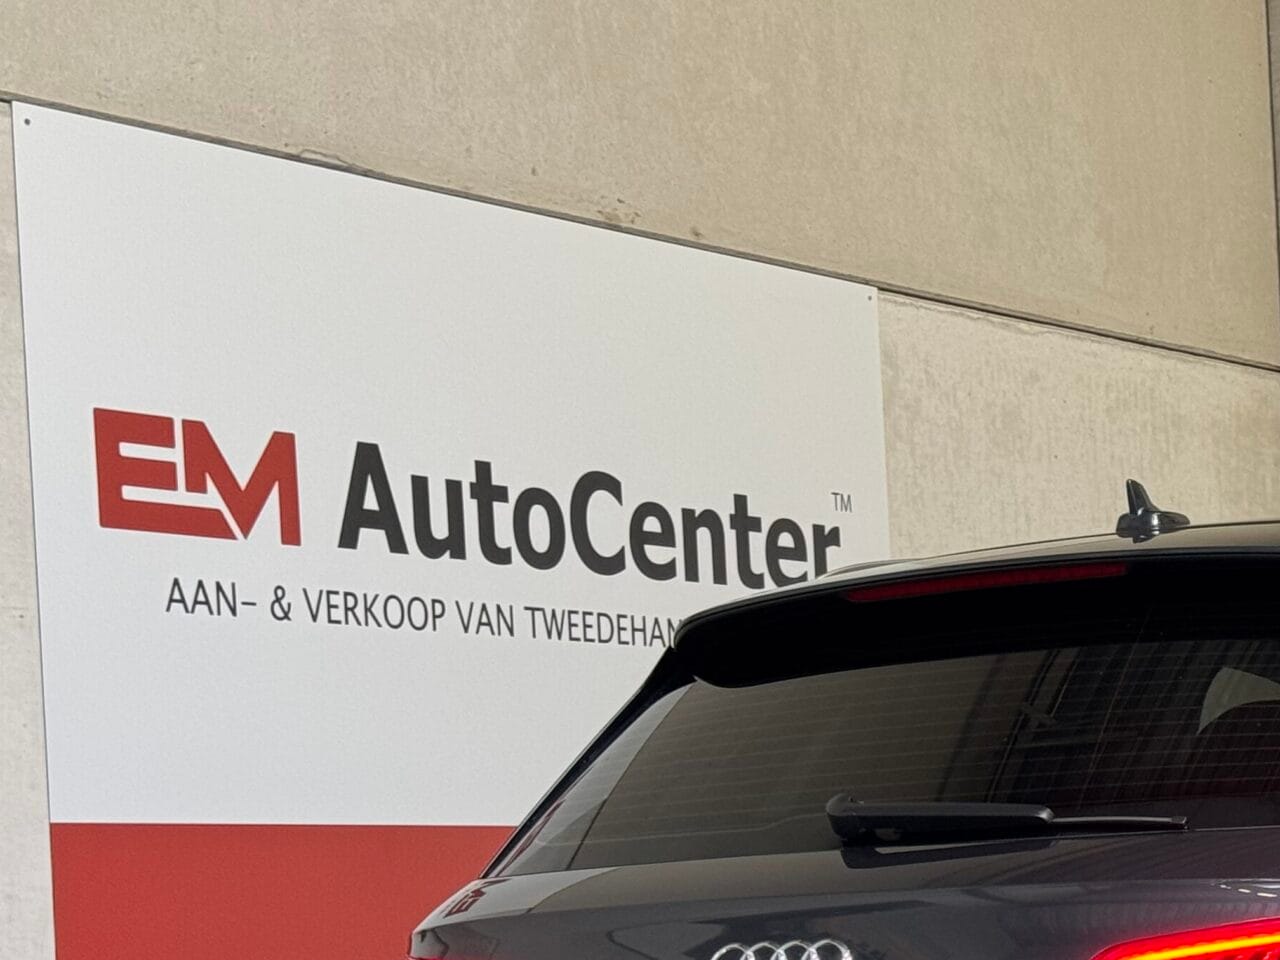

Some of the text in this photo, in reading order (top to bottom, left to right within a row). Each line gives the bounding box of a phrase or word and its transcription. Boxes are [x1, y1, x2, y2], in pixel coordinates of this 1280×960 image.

[94, 409, 300, 545] EM
[337, 441, 841, 590] AutoCenter
[165, 577, 257, 617] AAN-
[270, 585, 292, 621] &
[302, 588, 446, 632] VERKOOP
[455, 600, 515, 637] VAN
